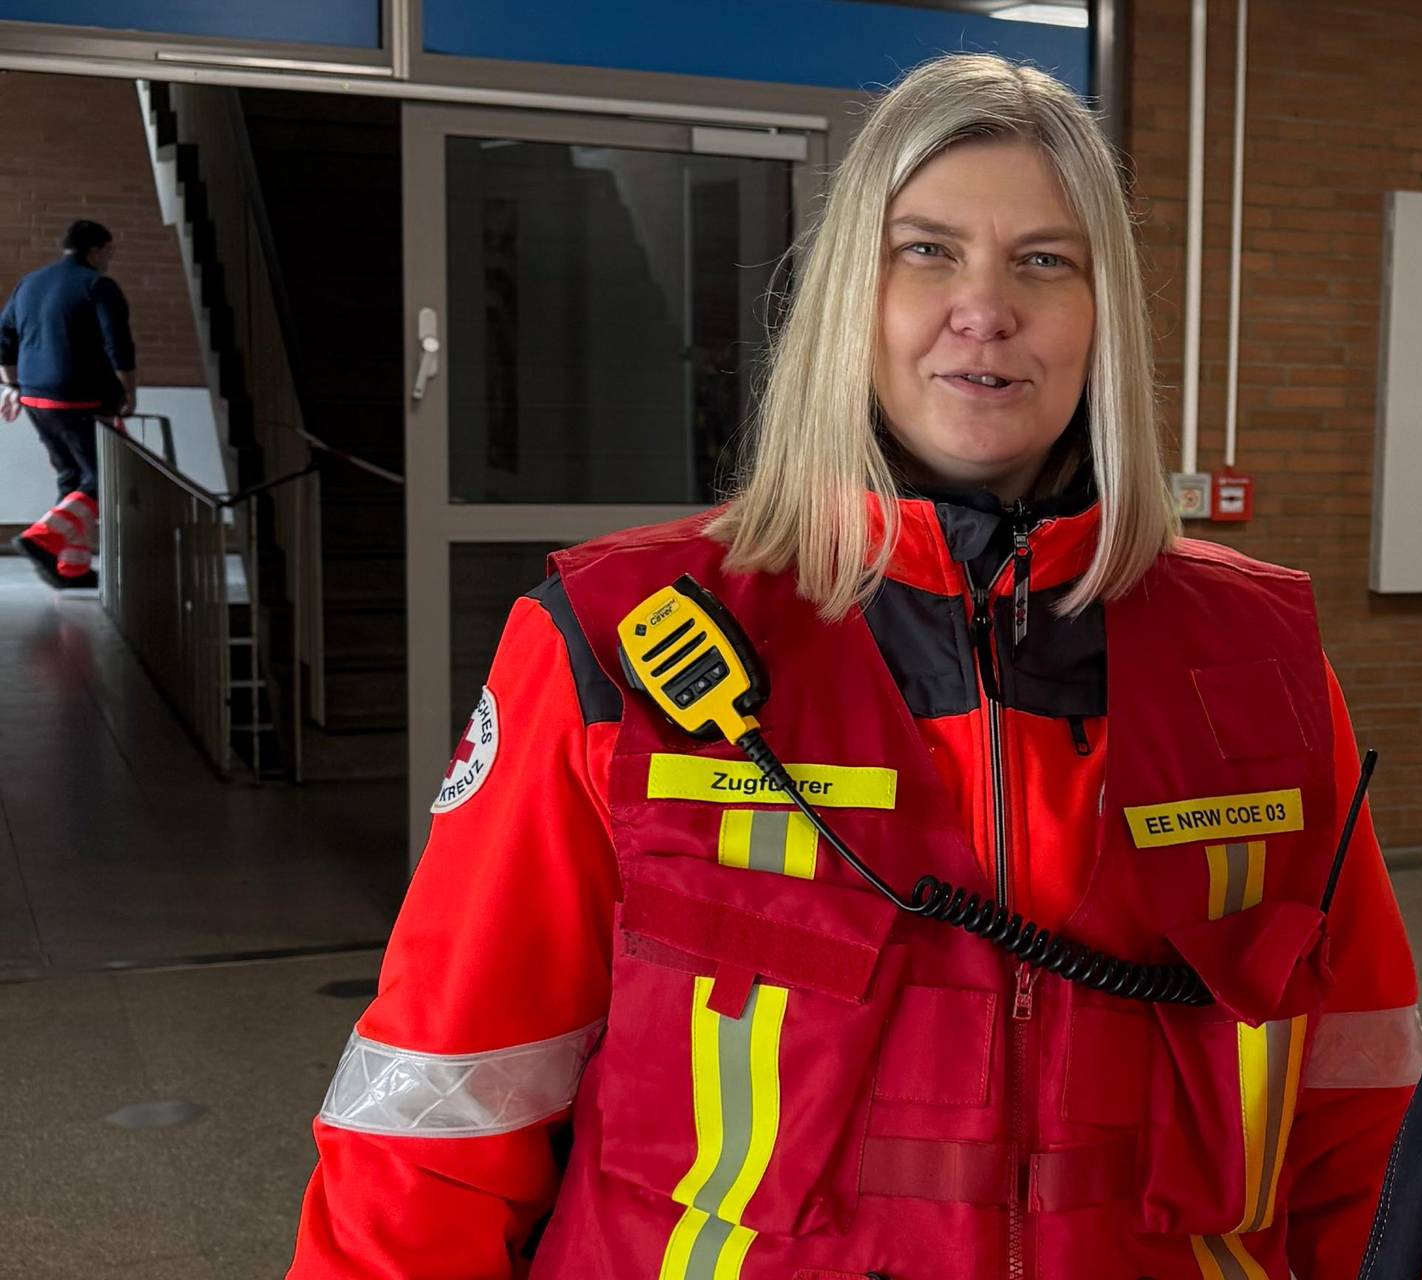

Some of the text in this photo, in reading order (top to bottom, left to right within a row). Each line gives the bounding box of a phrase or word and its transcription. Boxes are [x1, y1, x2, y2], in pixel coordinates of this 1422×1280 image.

[711, 772, 833, 794] Zugfrer
[1145, 803, 1286, 835] EE NRW COE 03
